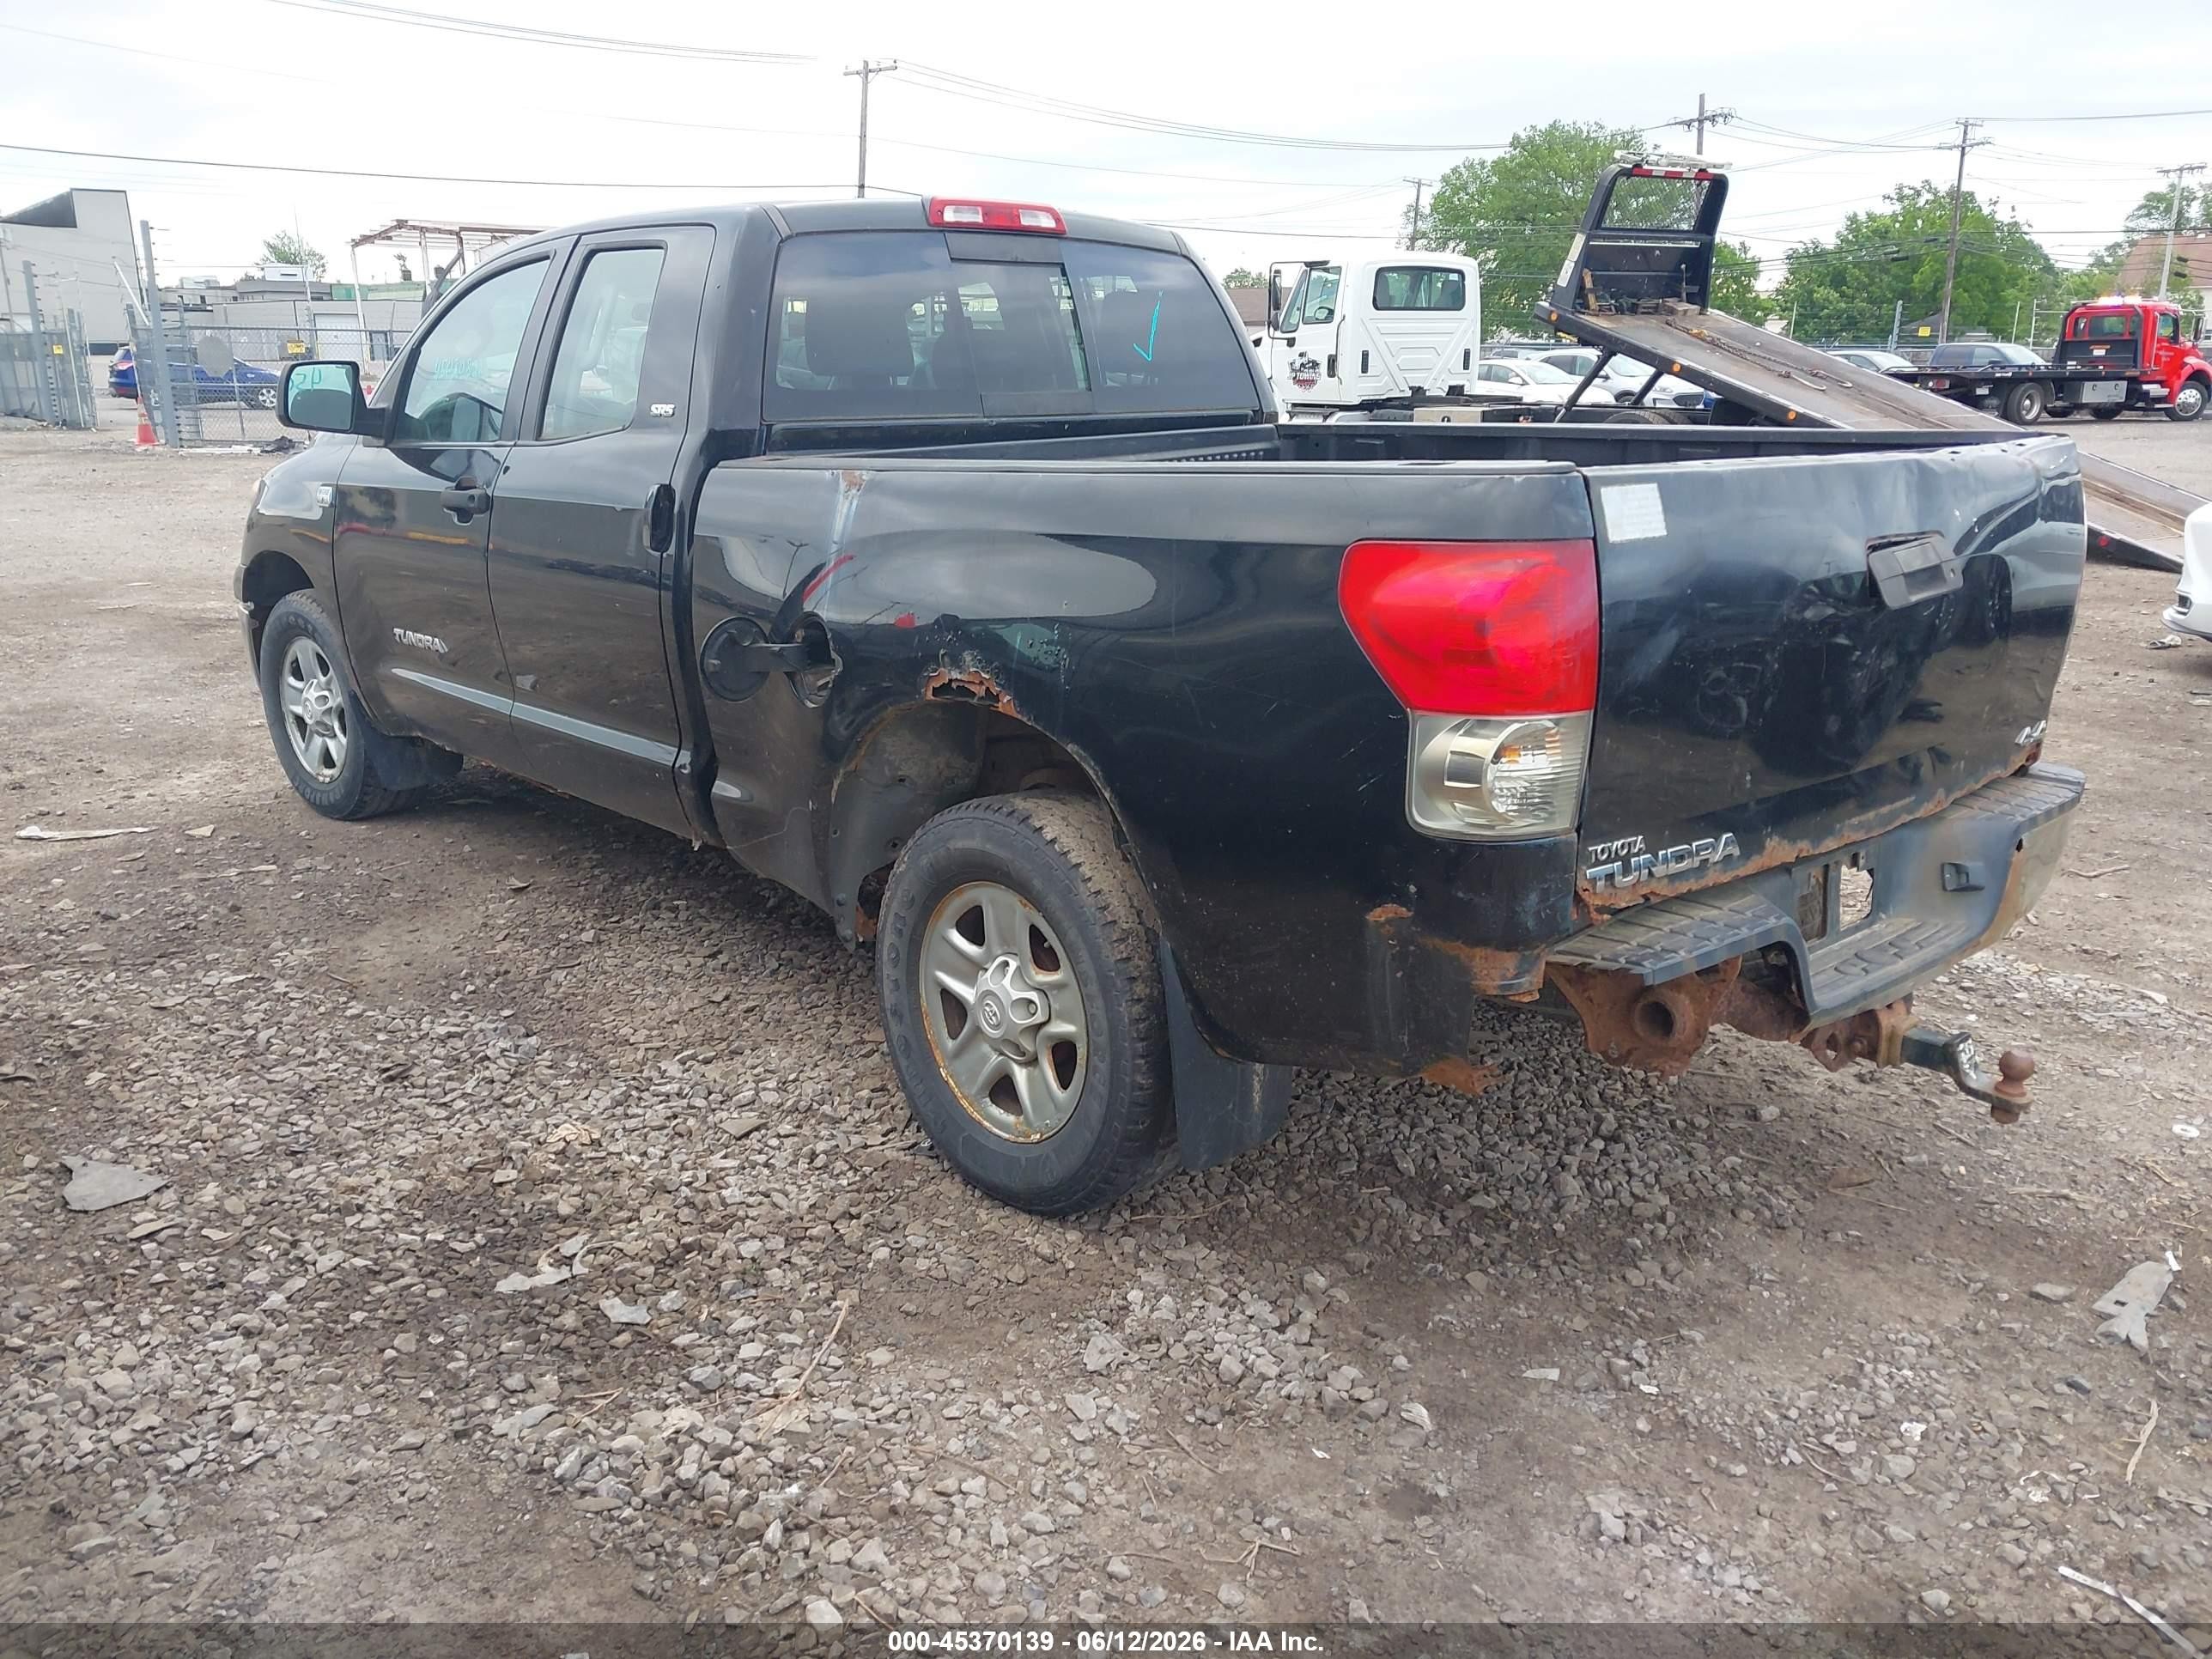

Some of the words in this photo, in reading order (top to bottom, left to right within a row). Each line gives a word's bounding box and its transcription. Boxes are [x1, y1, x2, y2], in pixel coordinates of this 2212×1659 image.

[393, 628, 448, 653] TUNDRA
[1586, 832, 1741, 892] TUNDRA
[1588, 836, 1646, 863] TOYOTA
